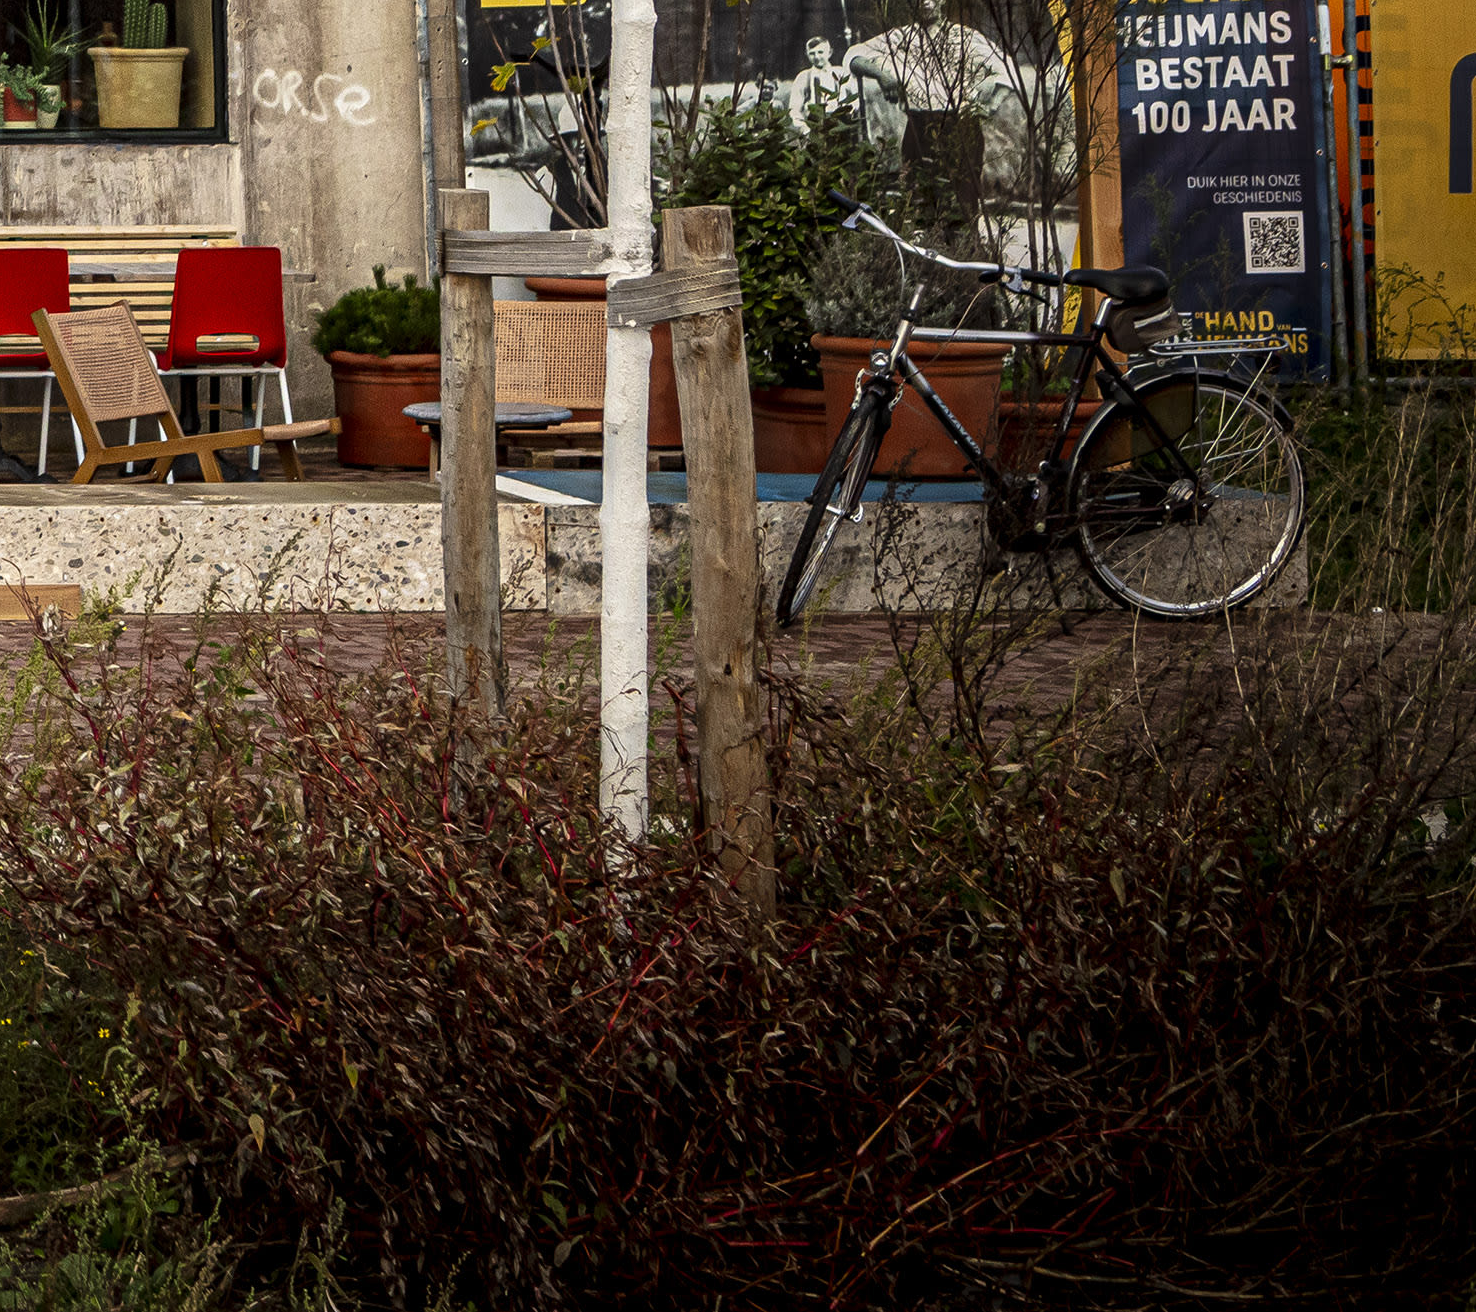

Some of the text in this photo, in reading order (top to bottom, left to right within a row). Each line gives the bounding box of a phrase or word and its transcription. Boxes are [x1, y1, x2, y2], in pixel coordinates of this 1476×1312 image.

[1135, 54, 1295, 91] BESTAAT
[1131, 98, 1297, 135] 100 JAAR
[1187, 174, 1301, 188] DUIK HIER IN ONZE
[1213, 191, 1303, 204] GESCHIEDENIS
[1204, 310, 1274, 332] HAND
